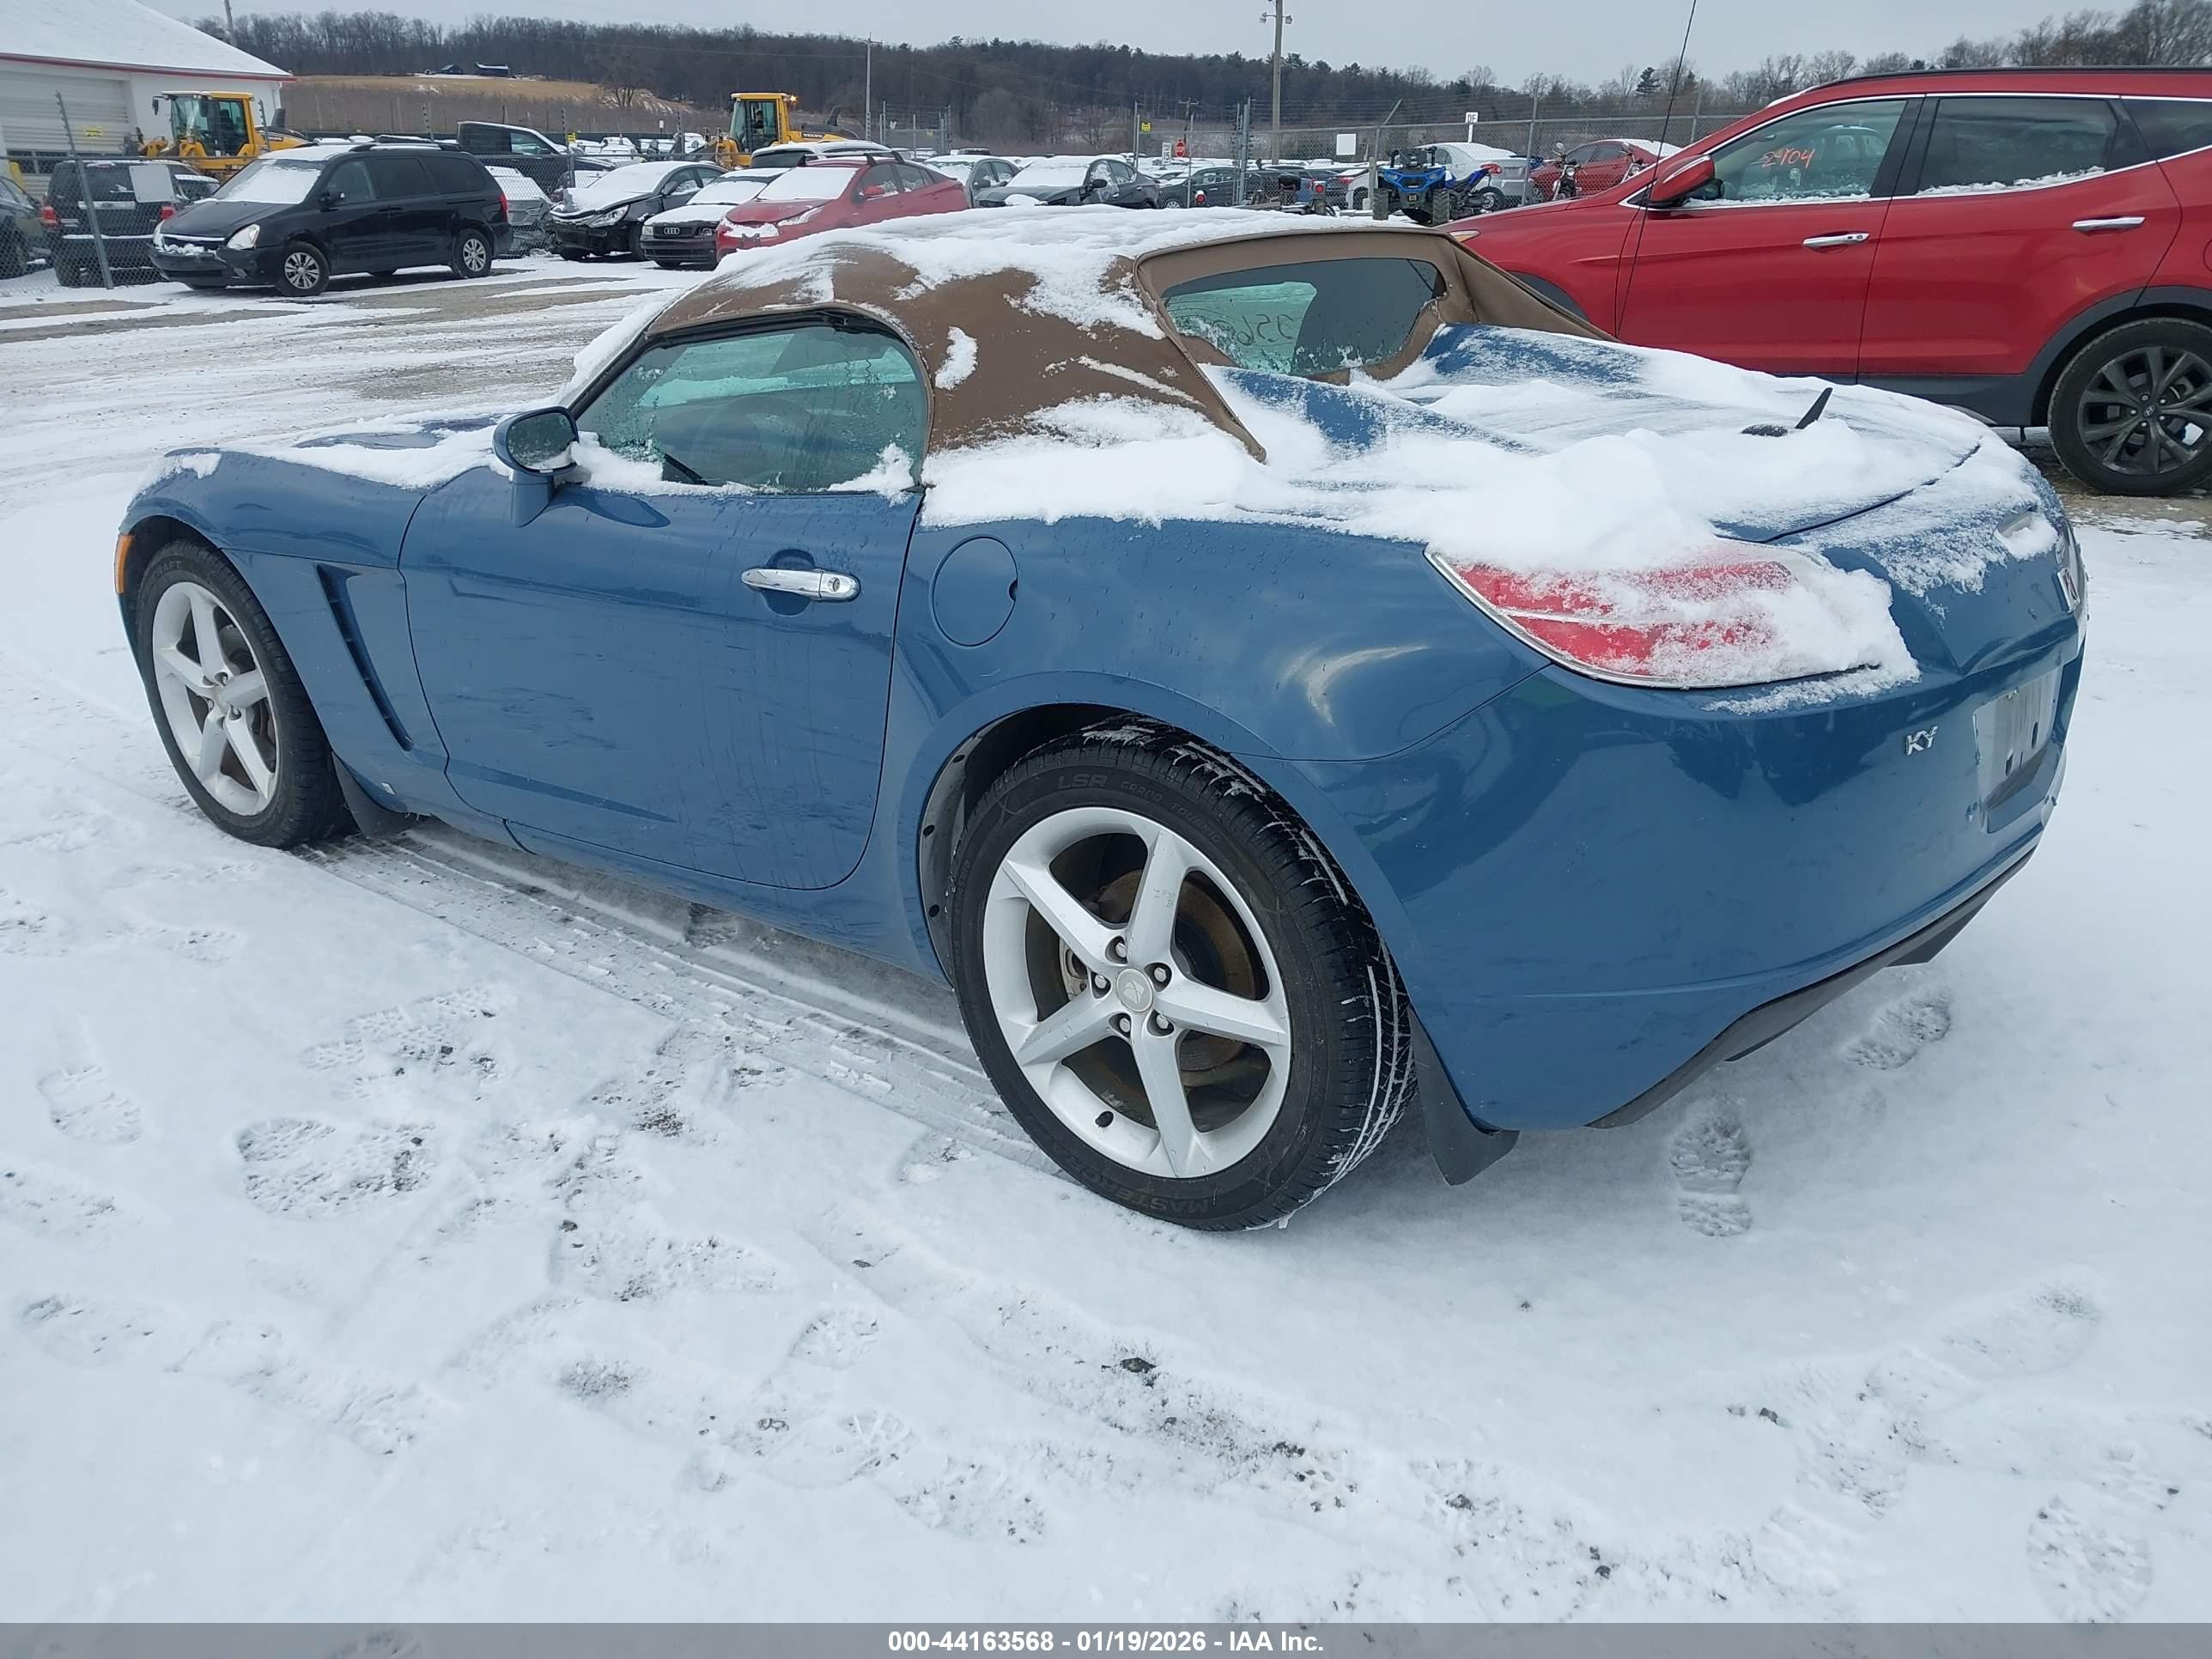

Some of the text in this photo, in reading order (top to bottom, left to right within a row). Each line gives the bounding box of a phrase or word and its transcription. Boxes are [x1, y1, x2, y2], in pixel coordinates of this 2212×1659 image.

[1905, 726, 1938, 756] KY
[1057, 774, 1108, 790] LSR
[1120, 781, 1164, 802] GRAND
